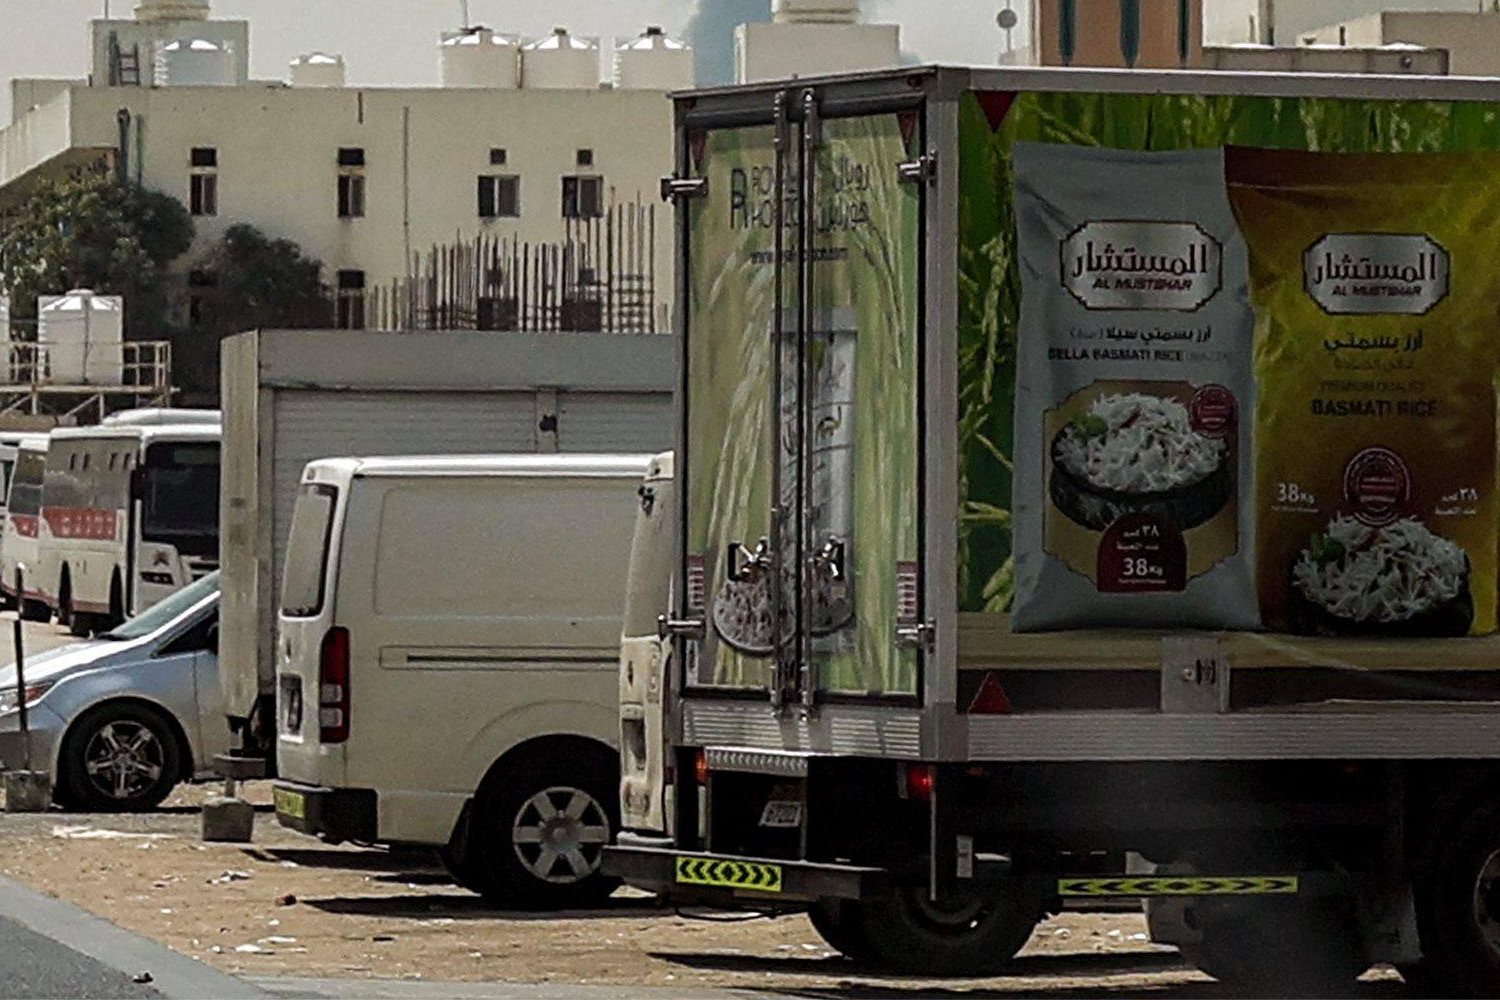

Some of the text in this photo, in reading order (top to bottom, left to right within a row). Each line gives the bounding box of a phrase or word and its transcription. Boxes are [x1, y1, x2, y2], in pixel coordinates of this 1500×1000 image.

[1072, 241, 1207, 277] المستشار
[1313, 252, 1436, 284] المستشار
[1311, 398, 1438, 416] BASMATI RICE
